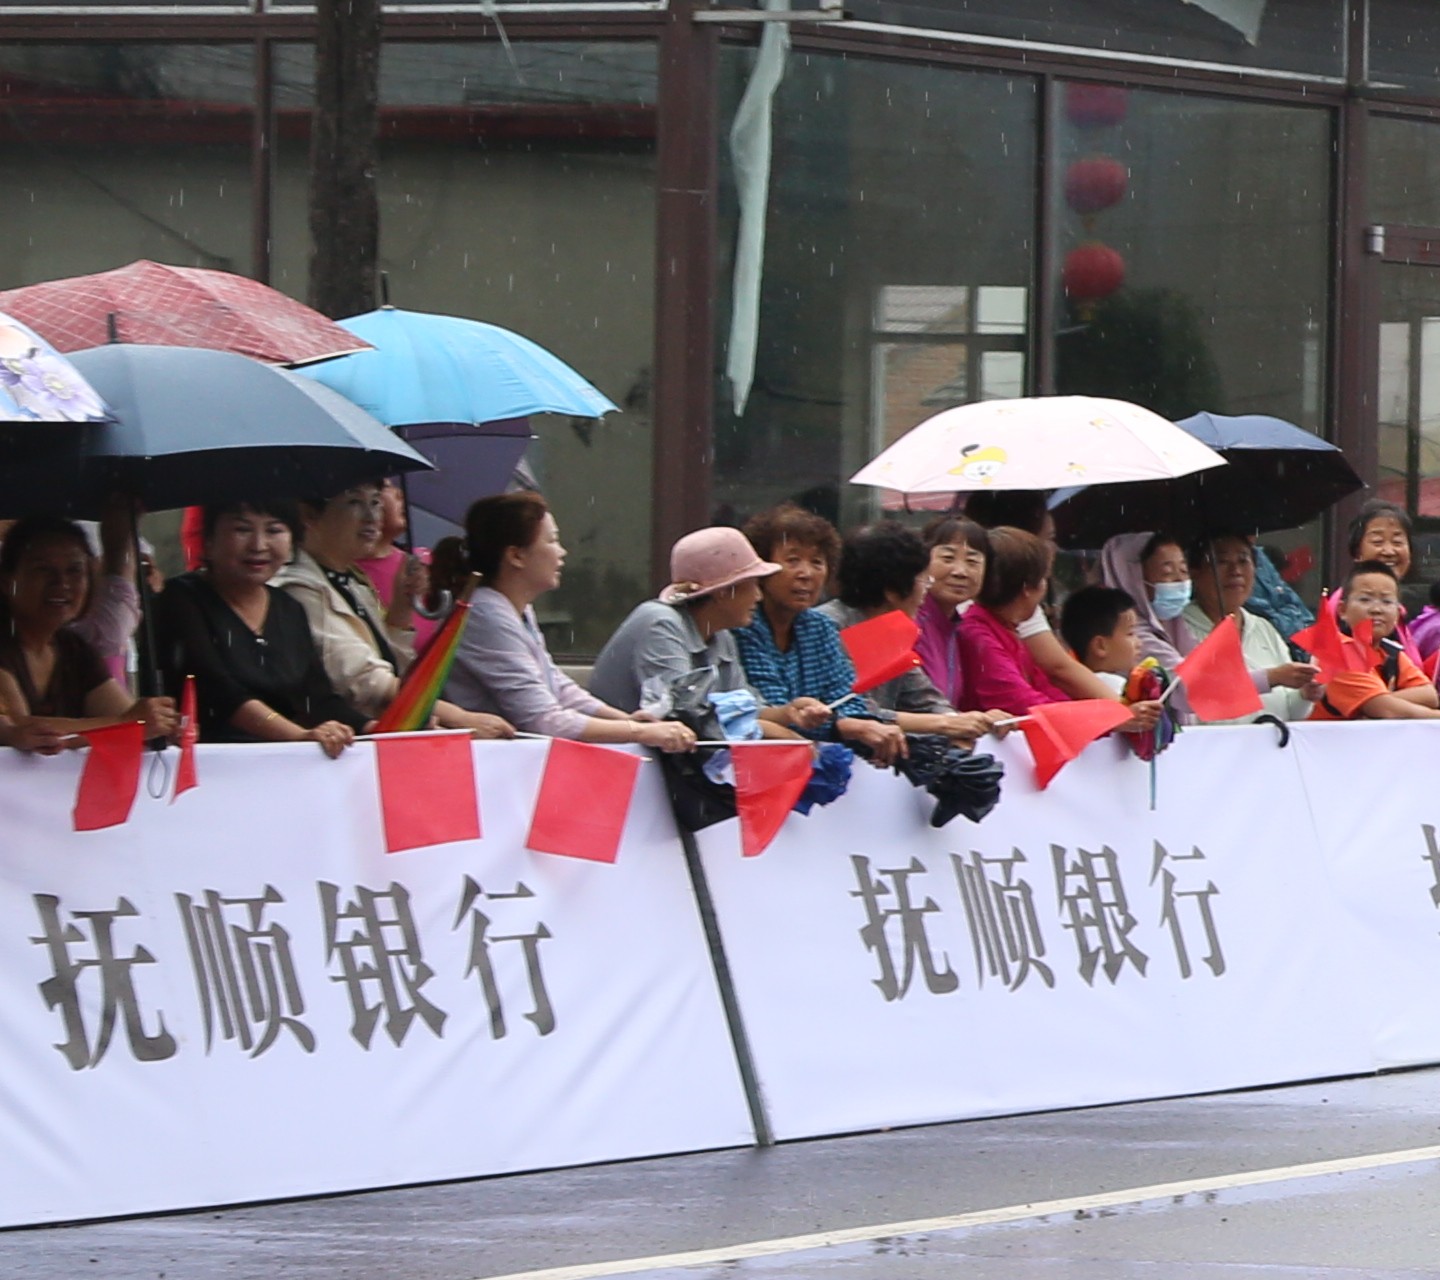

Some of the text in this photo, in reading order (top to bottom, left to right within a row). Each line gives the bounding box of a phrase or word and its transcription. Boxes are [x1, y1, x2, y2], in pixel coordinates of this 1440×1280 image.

[28, 874, 557, 1071] 抚顺银行
[849, 838, 1228, 1002] 抚顺银行
